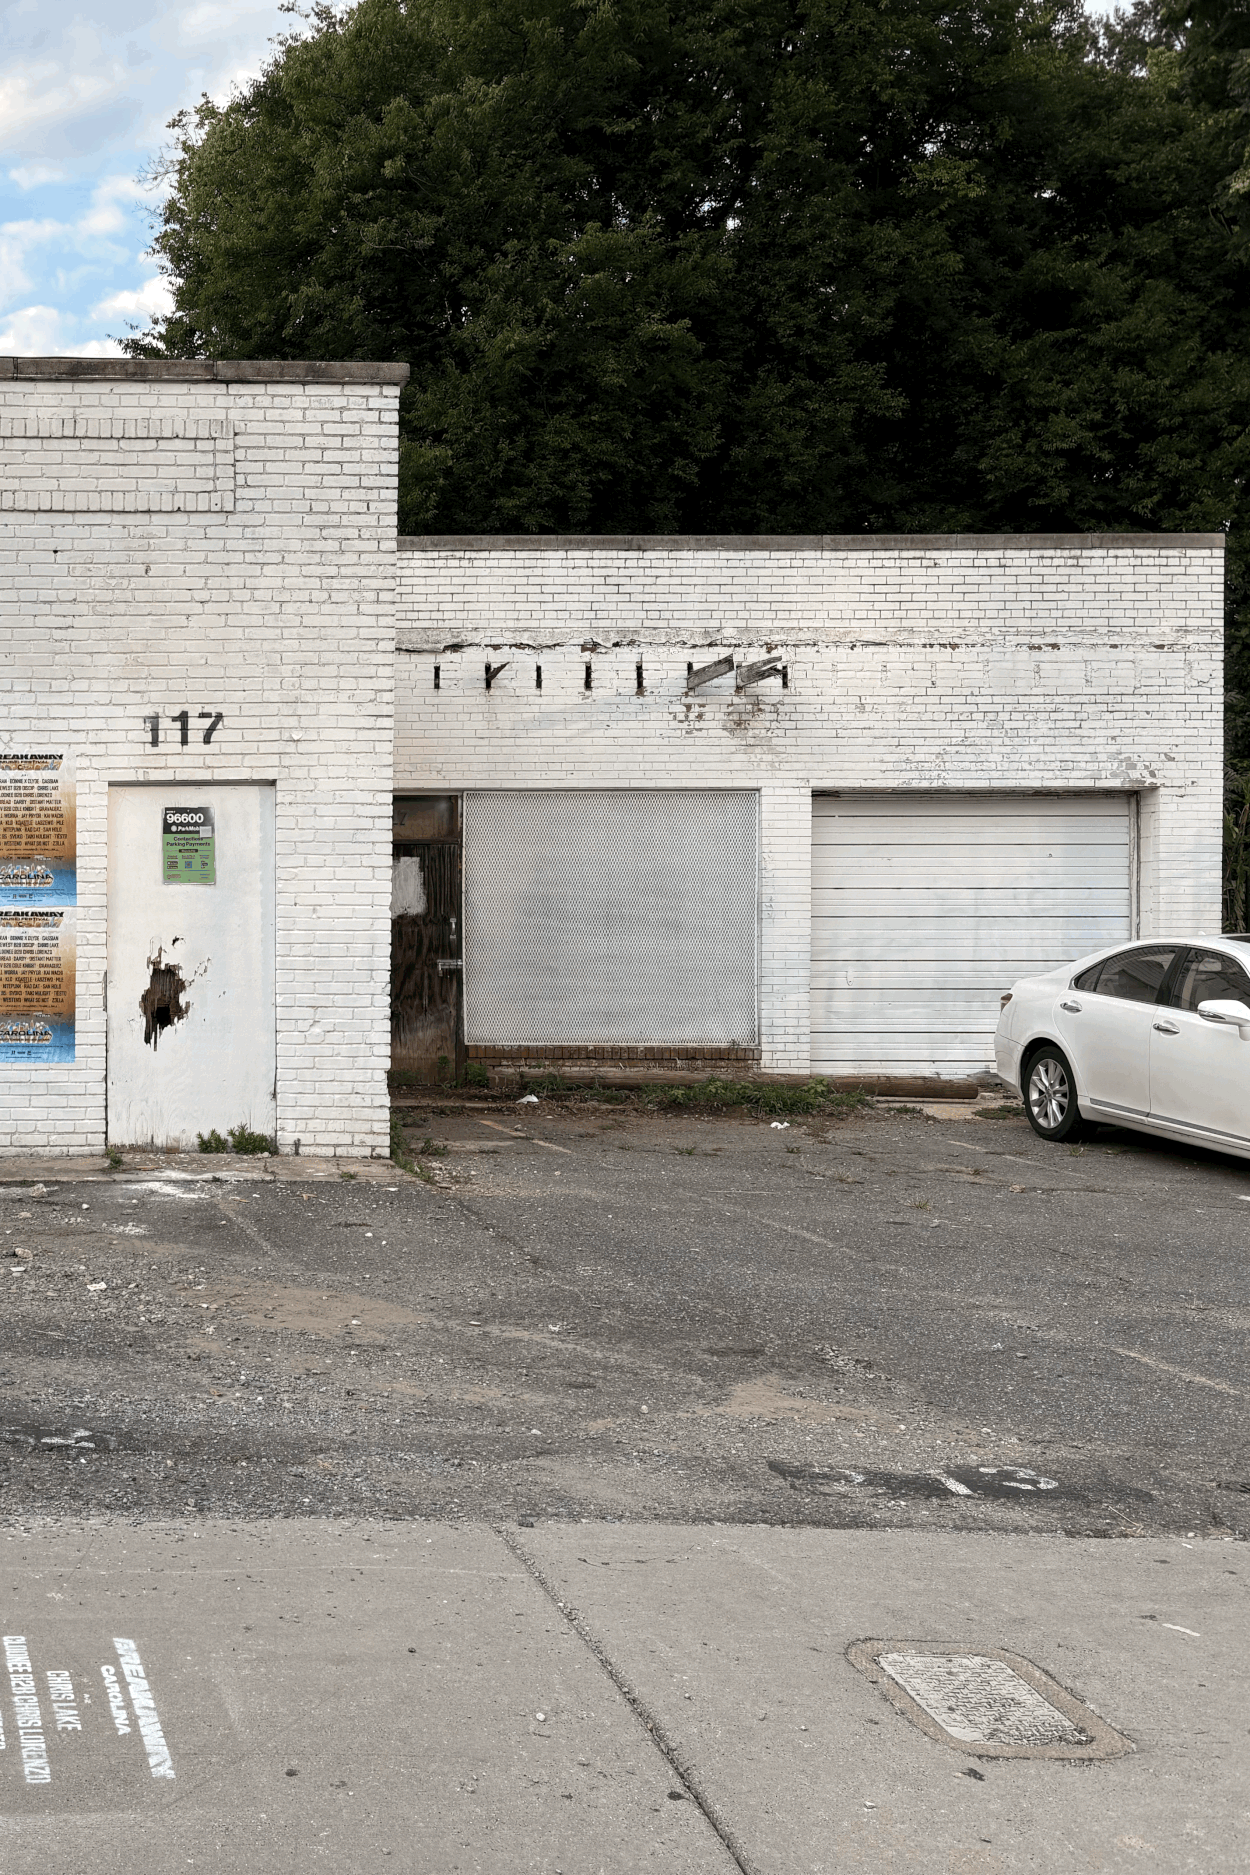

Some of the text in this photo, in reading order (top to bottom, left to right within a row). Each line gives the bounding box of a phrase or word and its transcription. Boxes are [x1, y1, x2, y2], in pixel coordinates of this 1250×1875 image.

[144, 711, 223, 747] 117
[166, 813, 204, 823] 96600
[2, 1635, 51, 1783] CLOONEE B2B CHRIS LORENZO
[46, 1670, 82, 1731] CHRIS LAKE
[100, 1665, 131, 1735] CAROLINA
[113, 1637, 176, 1779] BREAKAWAY
